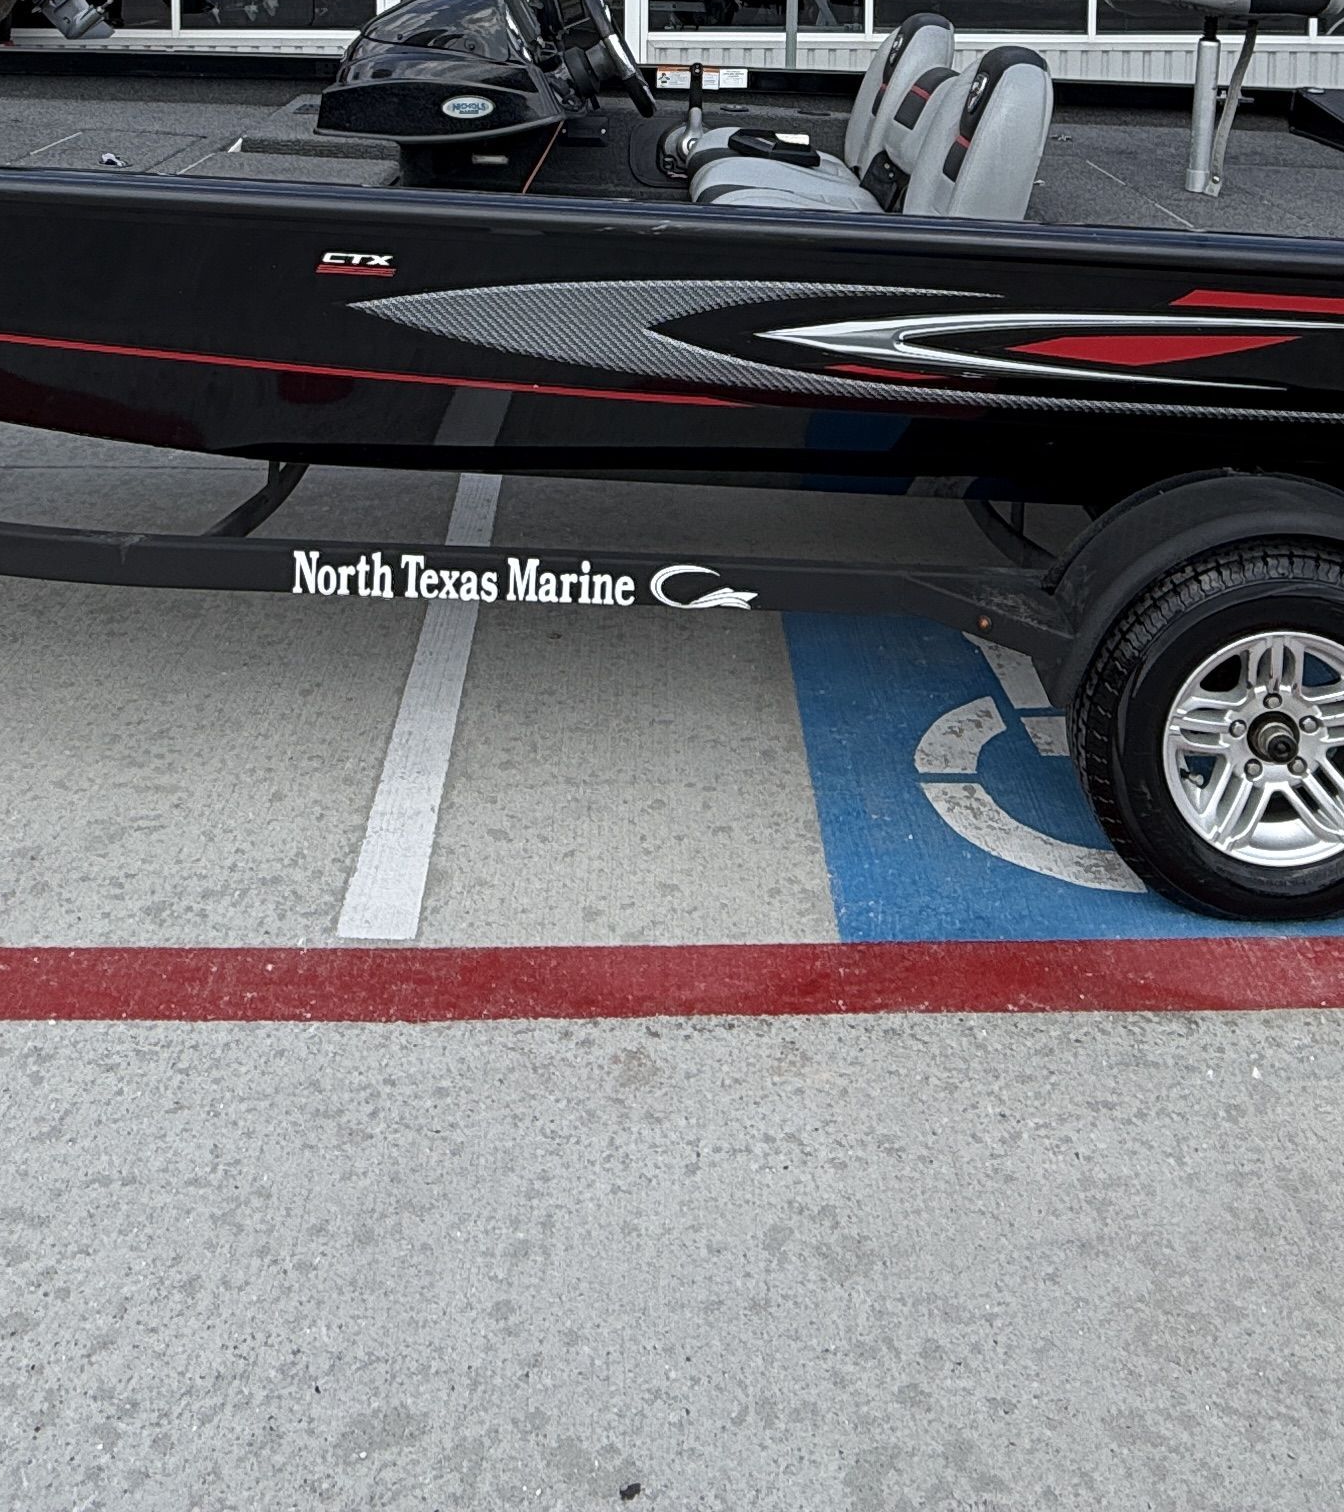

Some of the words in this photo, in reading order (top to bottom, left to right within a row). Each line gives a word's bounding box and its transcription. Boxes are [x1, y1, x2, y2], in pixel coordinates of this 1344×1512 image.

[322, 252, 394, 266] CTX
[293, 550, 394, 598] North
[401, 554, 498, 603] Texas
[506, 557, 636, 606] Marine
